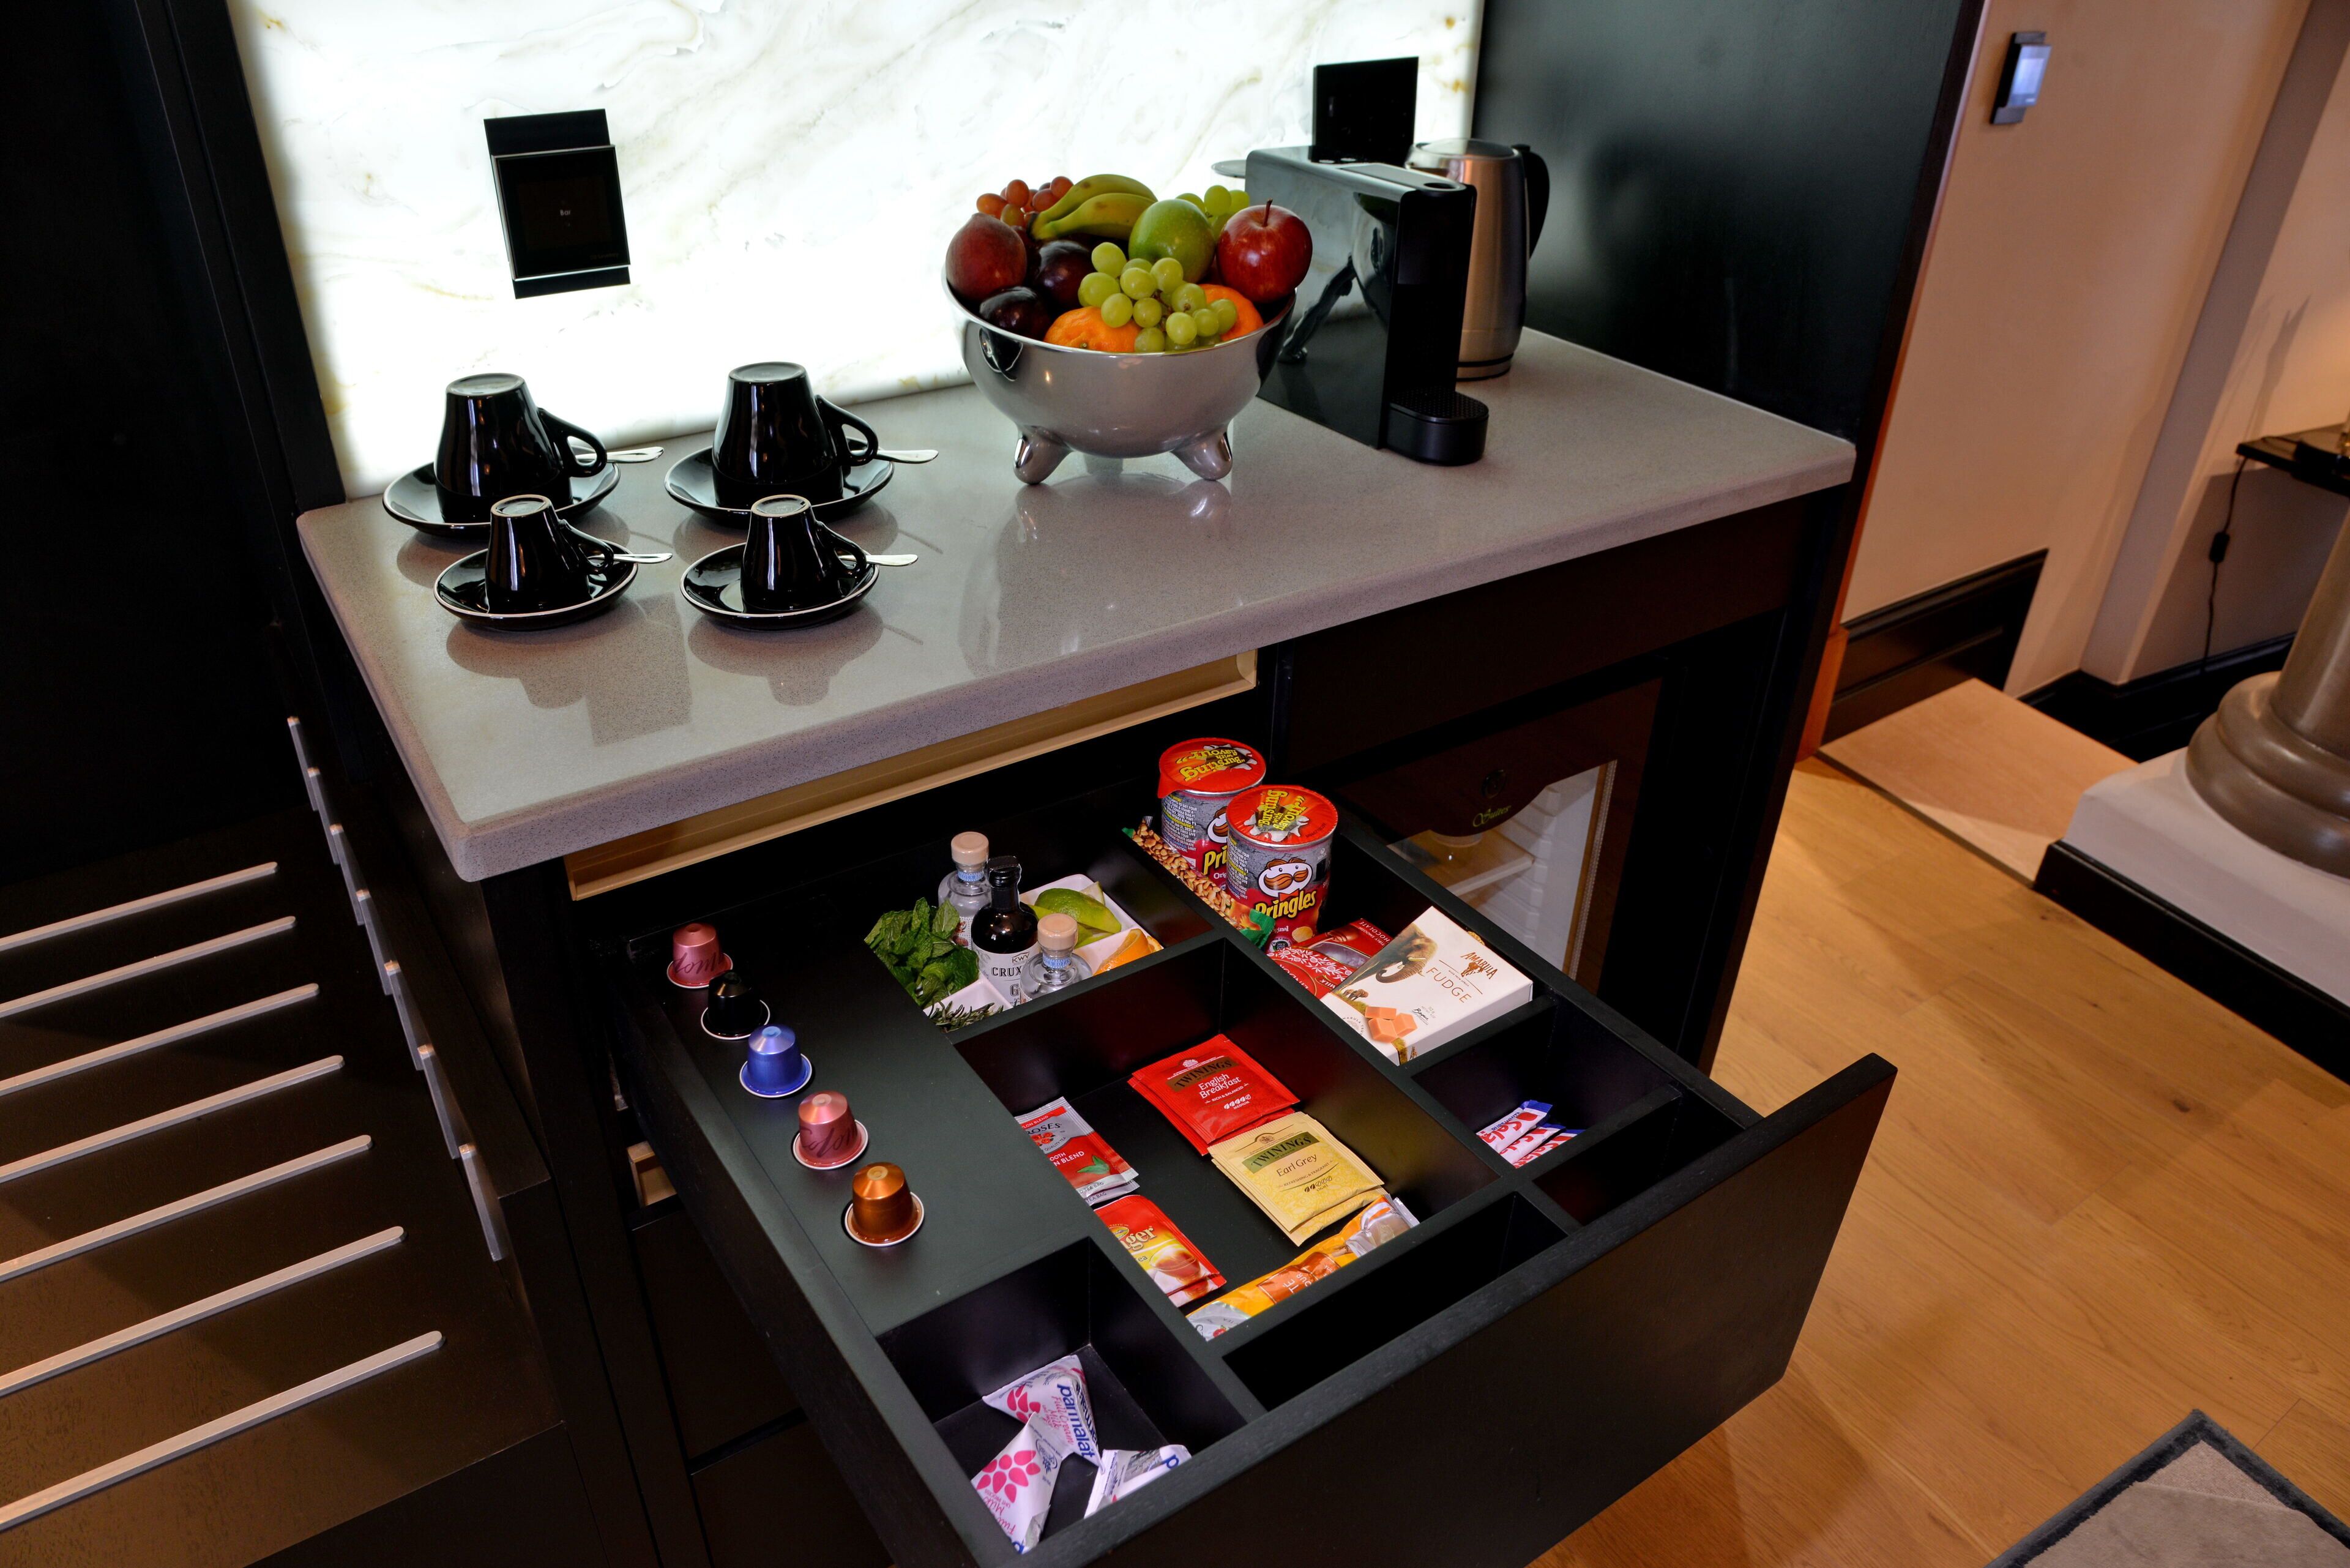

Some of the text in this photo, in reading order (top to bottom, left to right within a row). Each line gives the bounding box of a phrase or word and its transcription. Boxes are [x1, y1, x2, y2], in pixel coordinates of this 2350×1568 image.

[1272, 812, 1283, 826] with
[1359, 921, 1390, 943] HOCOLATE
[1012, 954, 1029, 963] KWV
[1460, 952, 1498, 980] AMARULA
[991, 965, 1022, 977] CRUX
[1319, 979, 1337, 989] MILK
[1426, 967, 1472, 1003] FUDGE
[1343, 1015, 1362, 1025] MARULA
[1174, 1060, 1233, 1088] TWININGS
[1198, 1073, 1230, 1091] English
[1199, 1076, 1242, 1099] Breakfast
[1226, 1086, 1244, 1097] BALANCED
[1034, 1115, 1049, 1125] BLEND
[1049, 1152, 1066, 1162] OOTH
[1062, 1151, 1085, 1165] BLEND
[1251, 1136, 1312, 1168] TWININGS
[1276, 1154, 1317, 1177] Earl Grey
[1121, 1226, 1157, 1251] ger
[1057, 1384, 1095, 1457] parmalat
